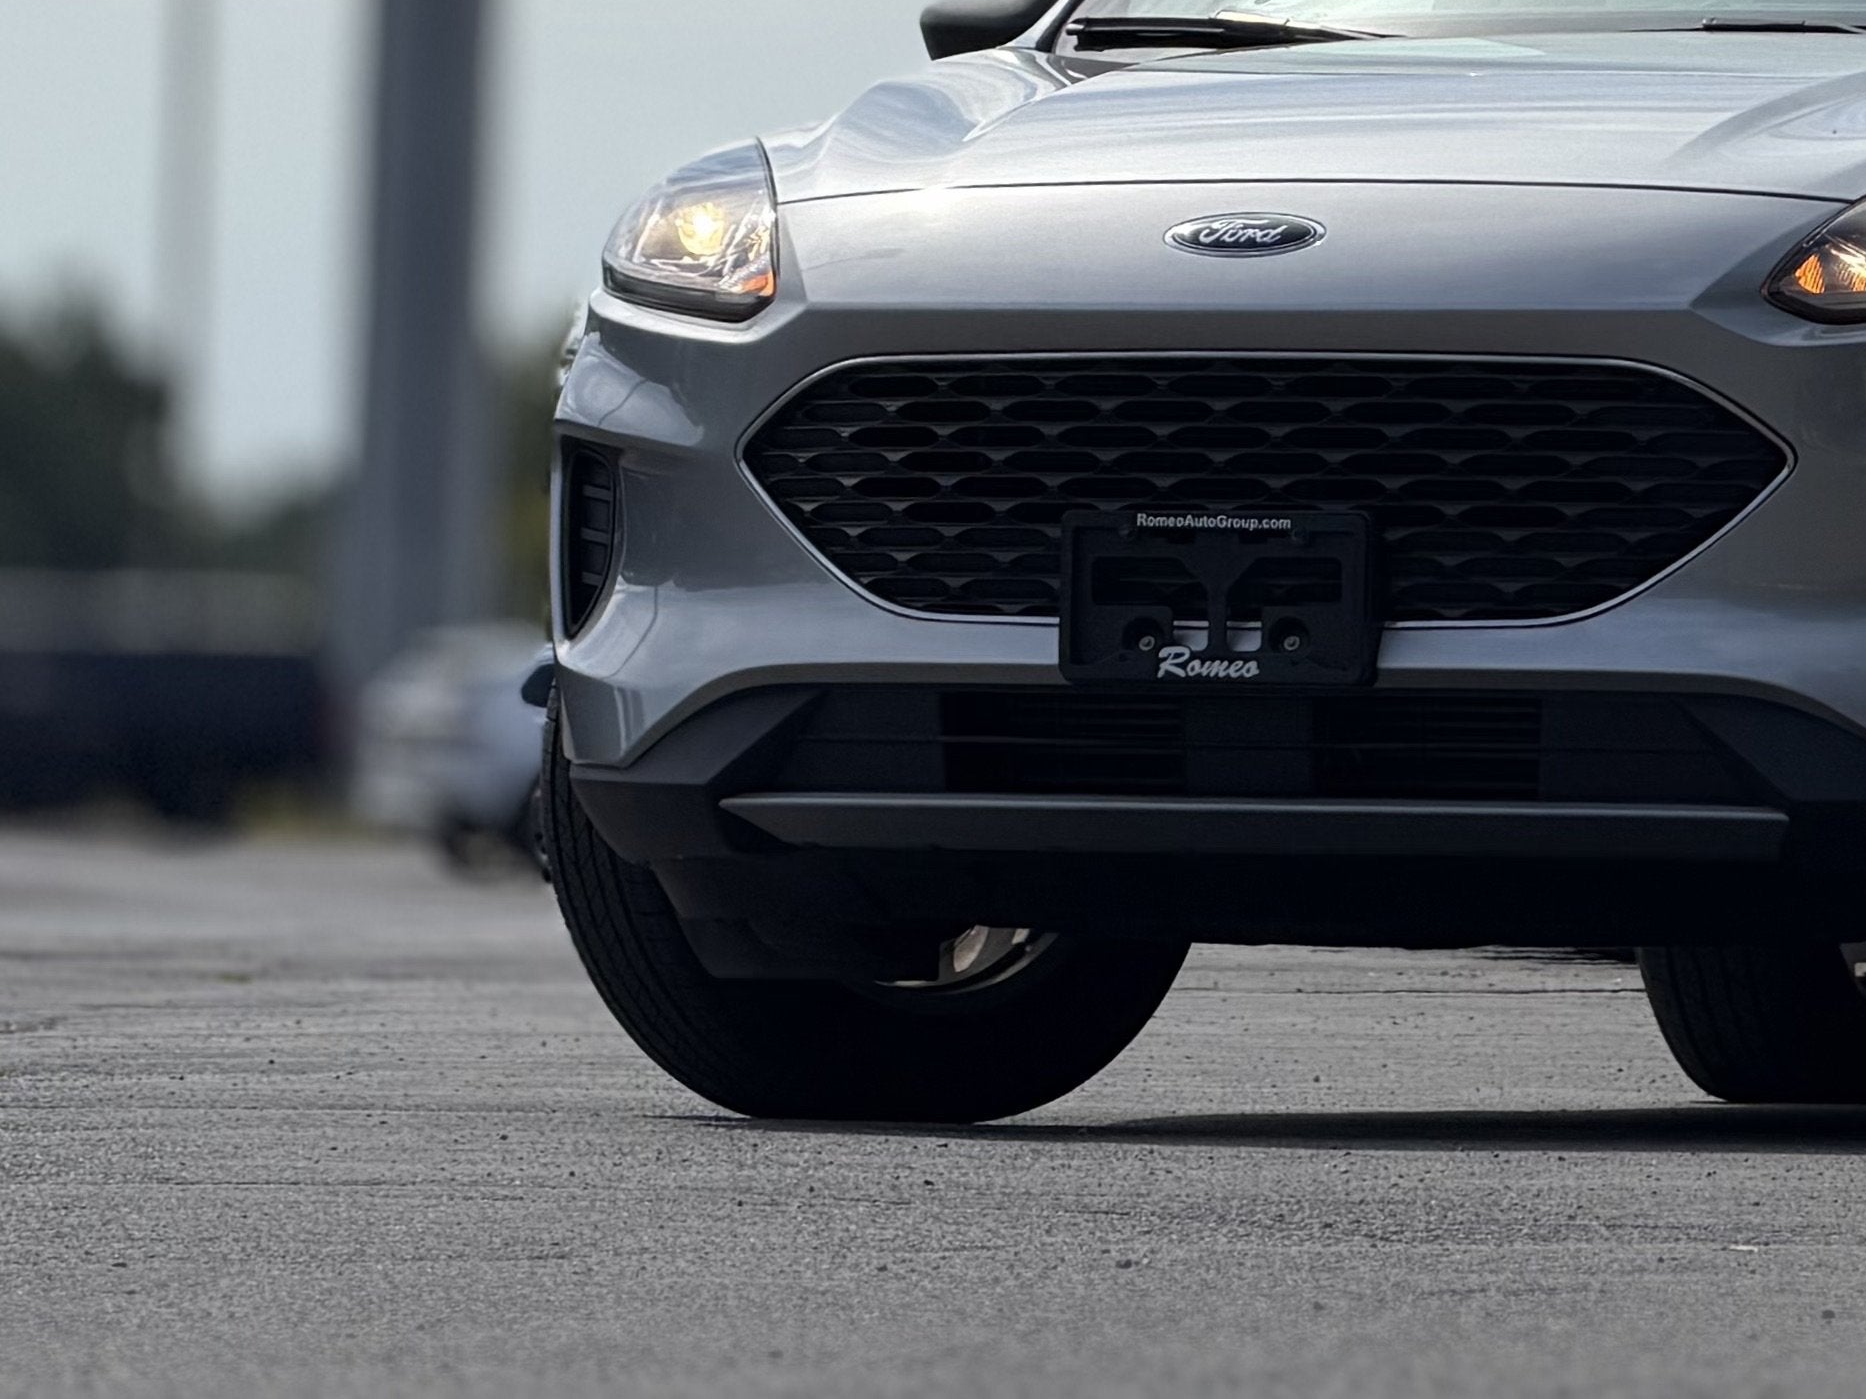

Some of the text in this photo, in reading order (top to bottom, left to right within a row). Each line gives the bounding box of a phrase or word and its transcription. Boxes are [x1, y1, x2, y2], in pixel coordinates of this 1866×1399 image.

[1199, 218, 1288, 244] Ford
[1136, 513, 1291, 531] RomeoAutoGroup.com
[1157, 646, 1259, 678] Romeo
